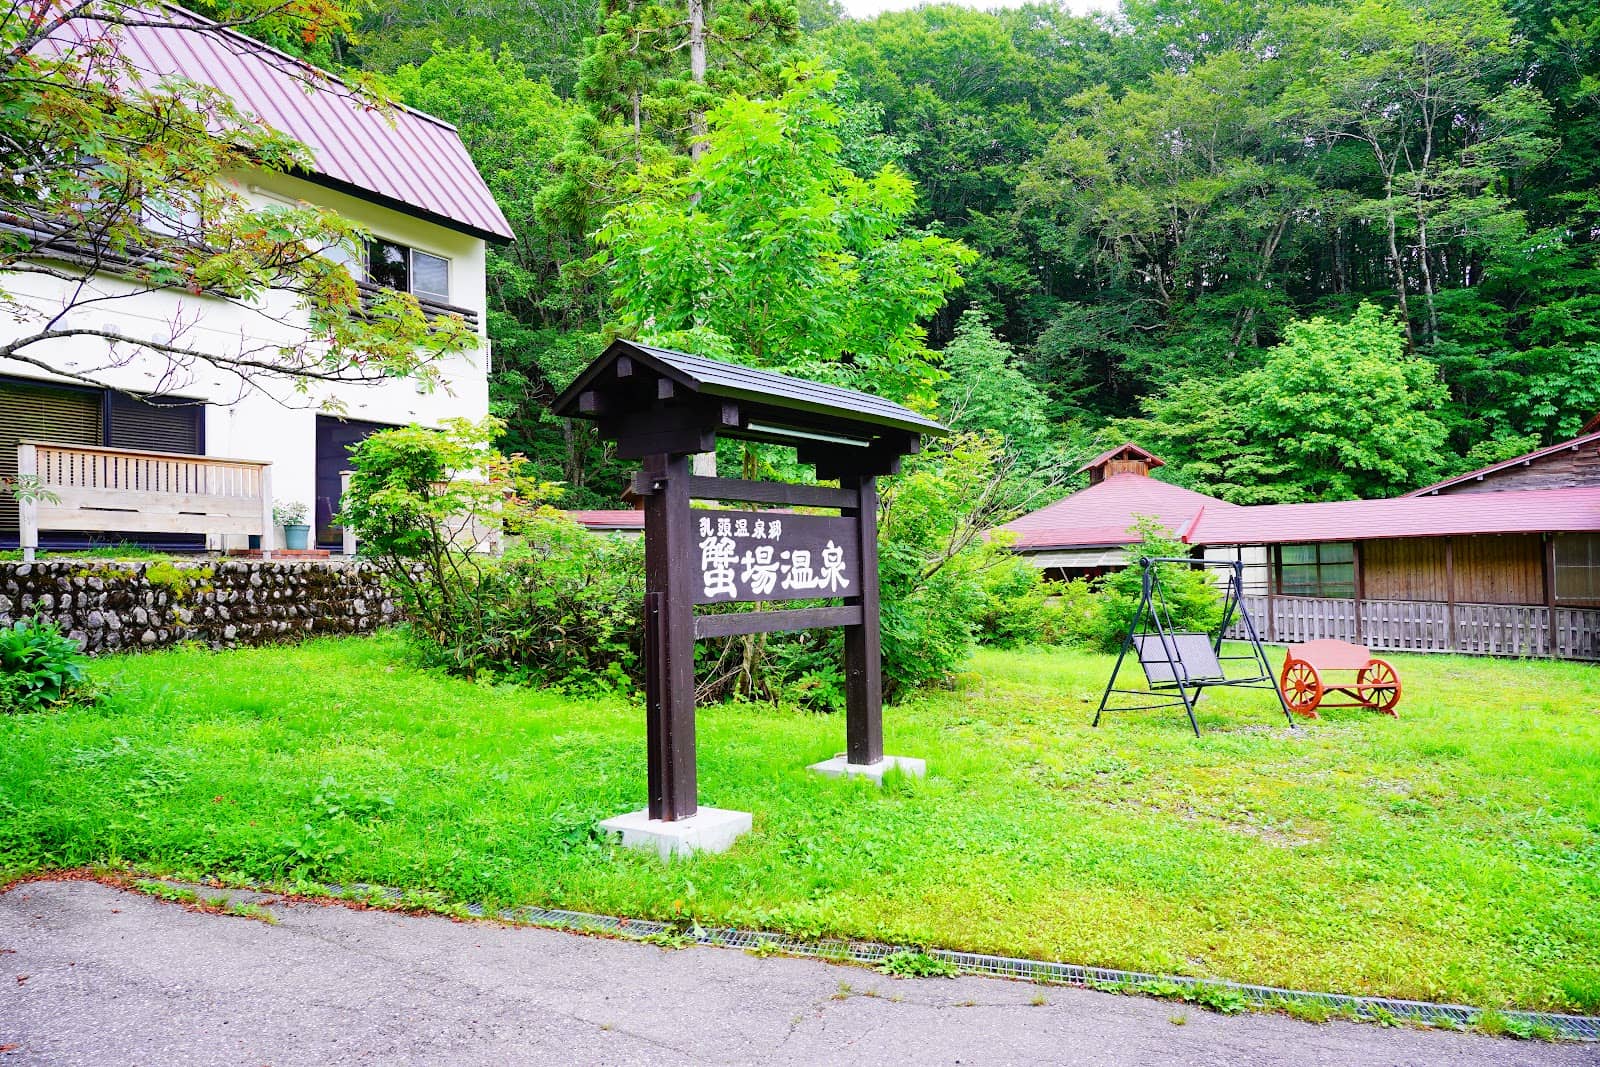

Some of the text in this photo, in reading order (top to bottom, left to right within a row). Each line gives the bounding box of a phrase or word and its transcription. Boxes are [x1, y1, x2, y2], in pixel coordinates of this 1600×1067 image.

[699, 516, 782, 542] 乳頭温泉郷
[699, 536, 850, 598] 蟹場温泉
